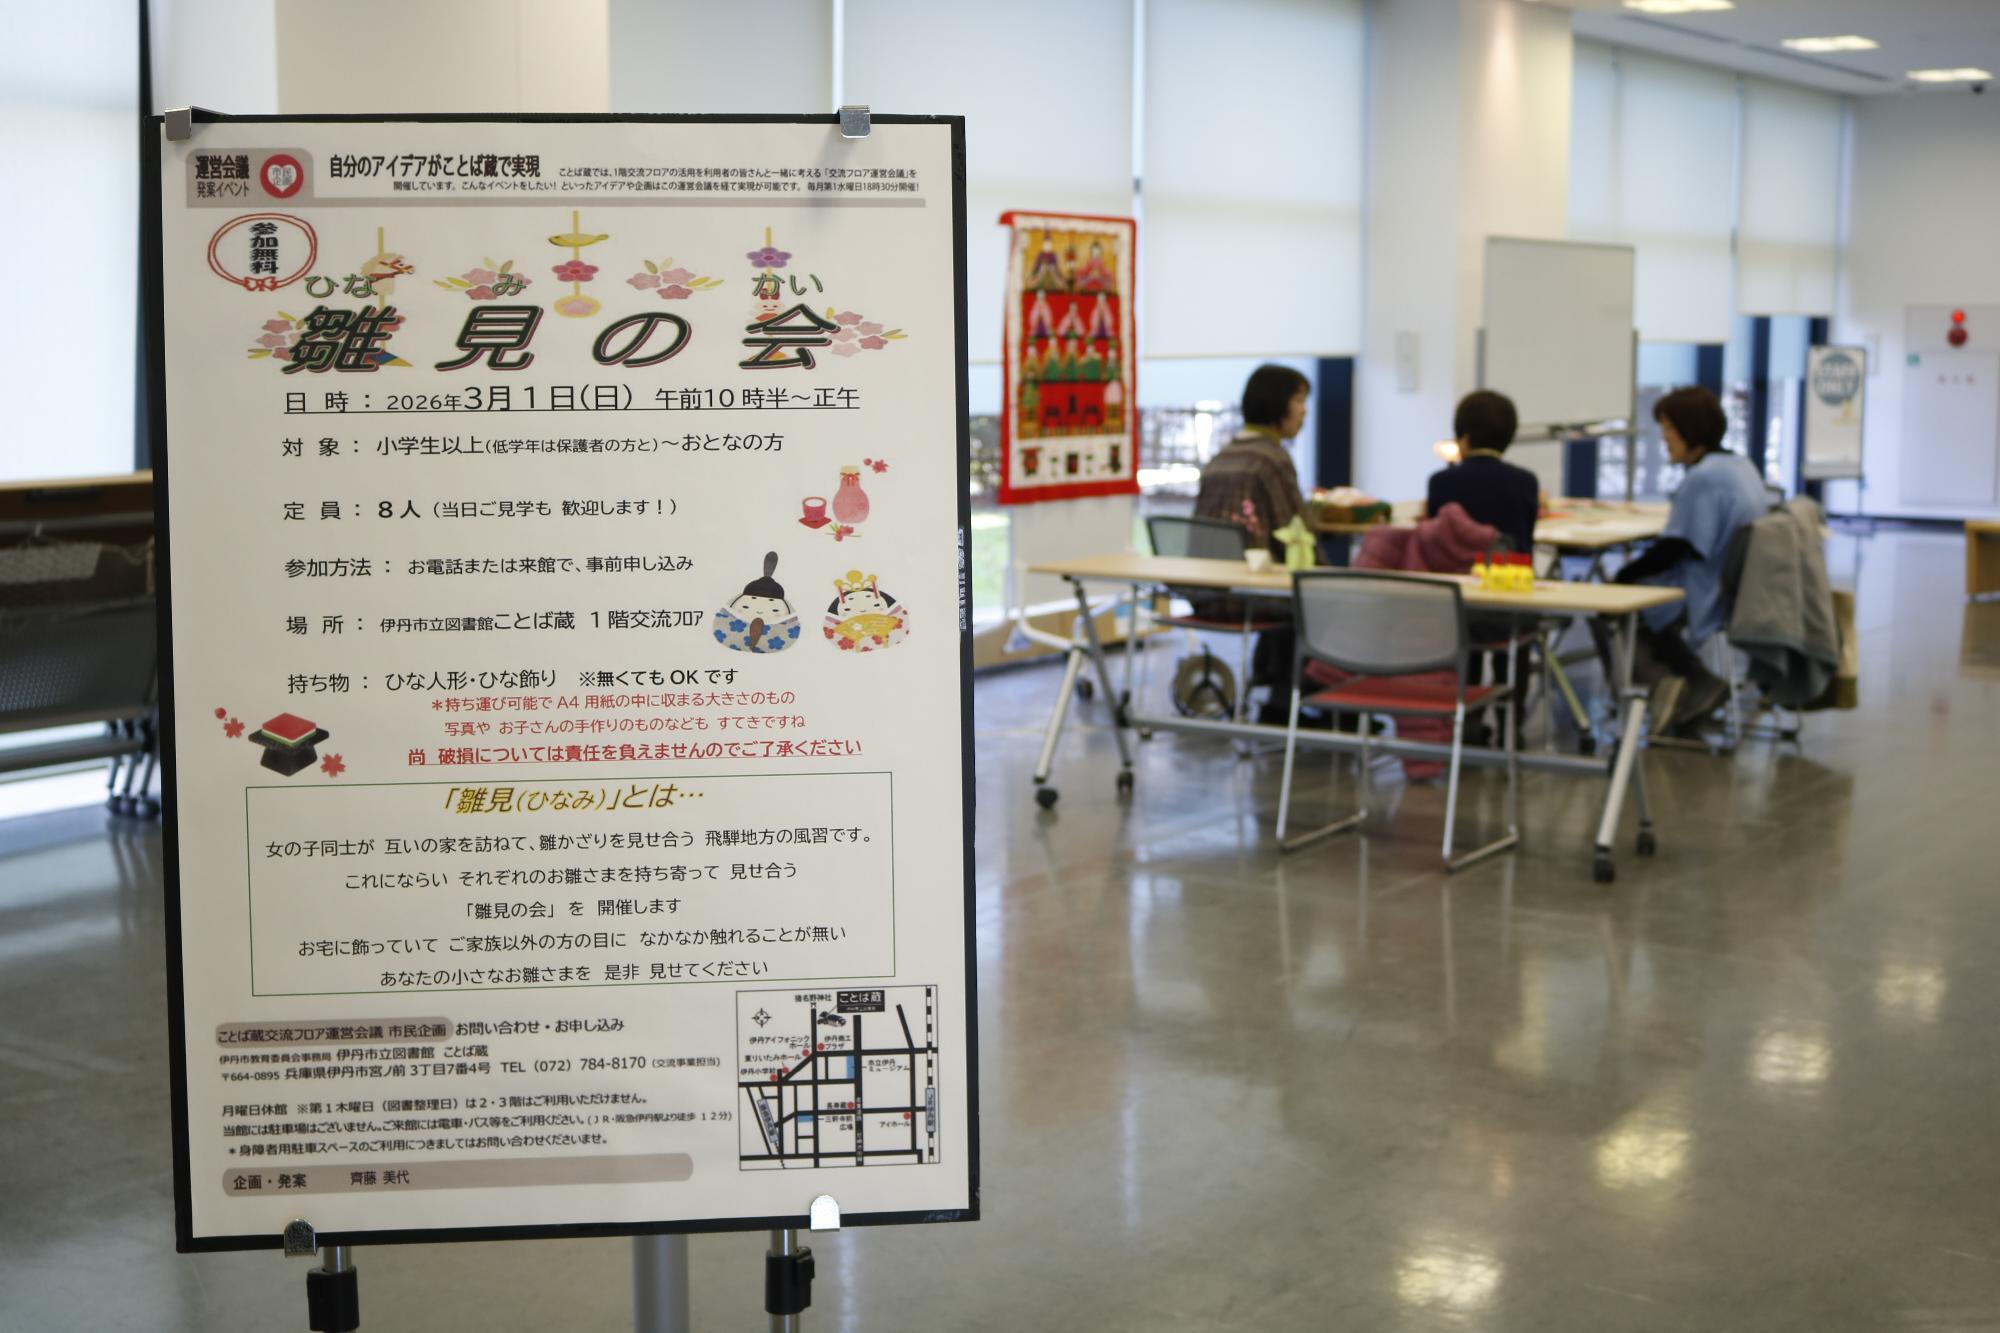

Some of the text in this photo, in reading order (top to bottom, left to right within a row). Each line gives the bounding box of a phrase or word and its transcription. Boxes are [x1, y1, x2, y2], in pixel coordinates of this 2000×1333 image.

[195, 154, 250, 179] 運営会議
[330, 154, 541, 178] 自分のアイデアがことば蔵で実現
[197, 180, 250, 198] 発案イベント
[304, 272, 824, 299] ひな み かい
[408, 555, 694, 576] お電話または来館で、事前申し込み
[380, 610, 576, 633] 伊丹市立図書館ことば蔵
[385, 669, 556, 691] ひな人形・ひな飾り
[445, 714, 806, 737] 写真や お子さんの手作りのものなども すてきですね
[408, 740, 863, 766] 尚 破損については責任を負えませんのでご了承ください
[265, 826, 872, 858] 女の子同士が 互いの家を訪ねて、雛かざりを見せ合う 飛騨地方の風習です。
[346, 862, 798, 889] これにならい それぞれのお雛さまを持ち寄って 見せ合う
[467, 898, 682, 919] 「雛見の会」 を 開催します
[298, 925, 847, 957] お宅に飾っていて ご家族以外の方の目に なかなか触れることが無い
[380, 960, 768, 987] あなたの小さなお雛さまを 是非 見せてください
[218, 1018, 625, 1044] ことば蔵交流フロア運営会議 市民企画 お問い合わせ・お申し込み
[336, 1046, 435, 1061] 伊丹市立図書館
[444, 1044, 489, 1058] ことば蔵
[222, 1103, 289, 1118] 月曜日休館
[233, 1173, 307, 1190] 企画・発案
[383, 1169, 410, 1185] 美代
